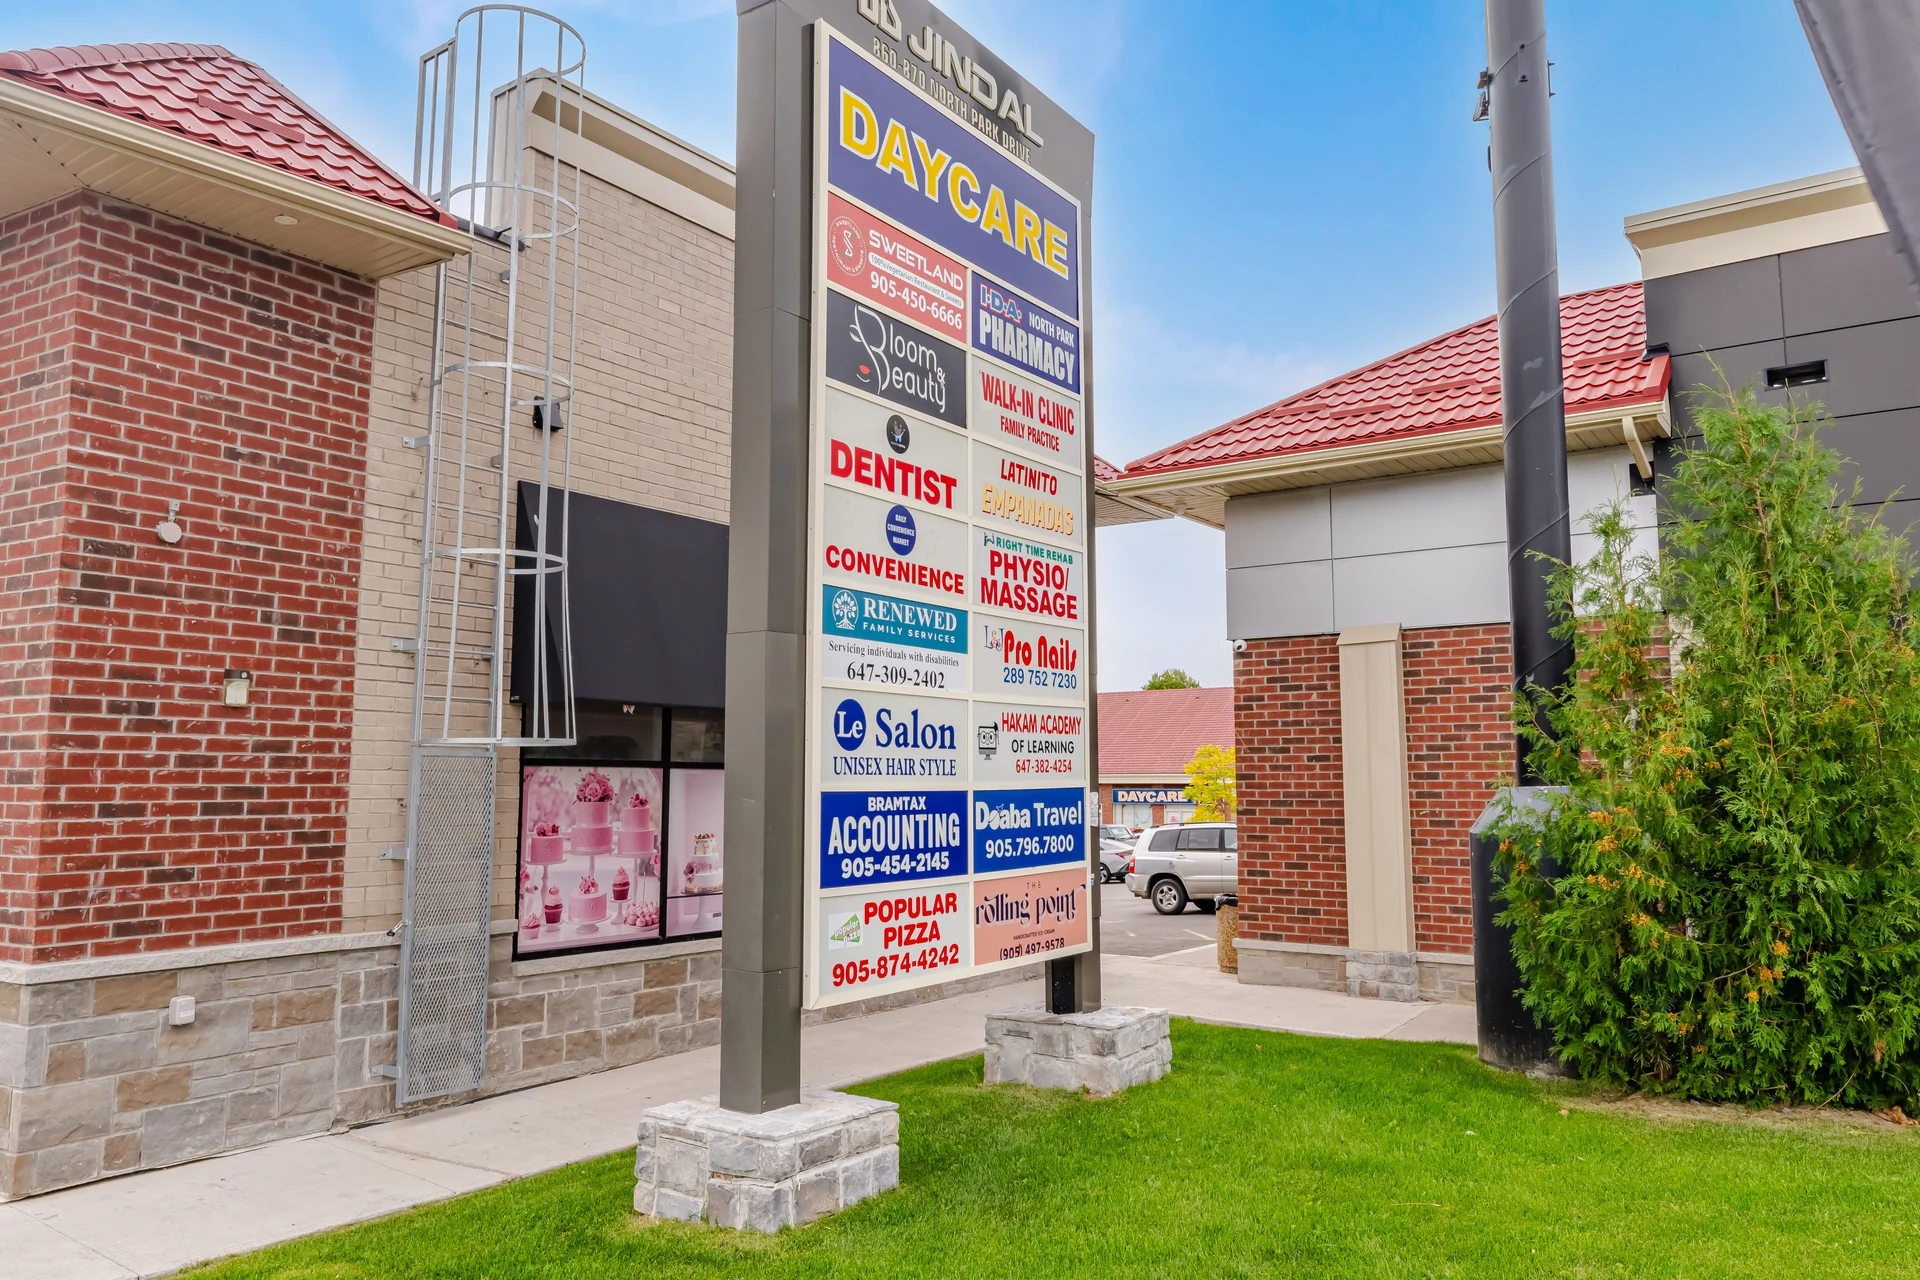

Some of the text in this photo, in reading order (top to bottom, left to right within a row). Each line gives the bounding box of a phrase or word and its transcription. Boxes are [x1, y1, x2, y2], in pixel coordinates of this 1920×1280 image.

[873, 36, 1031, 165] 860-870 NORTH PARK DRIVE
[907, 26, 1043, 147] JINDAL
[840, 85, 1068, 280] DAYCARE
[869, 229, 964, 291] SWEETLAND
[870, 271, 963, 330] 905-450-6666
[914, 276, 941, 296] Restaurant
[945, 293, 962, 307] Sweets
[980, 309, 1075, 385] PHARMACY
[1029, 312, 1075, 348] NORTH PARK
[936, 367, 946, 384] &
[981, 371, 1075, 436] WALK-IN CLINIC
[1000, 415, 1059, 452] FAMILY PRACTICE
[830, 438, 957, 509] DENTIST
[1000, 458, 1057, 495] LATINITO
[981, 482, 1074, 536] EMPANADAS
[996, 537, 1073, 565] RIGHT TIME REHAB
[825, 544, 964, 595] CONVENIENCE
[990, 549, 1069, 592] PHYSIO/
[863, 597, 957, 632] RENEWED
[981, 577, 1077, 620] MASSAGE
[863, 622, 956, 644] FAMILY SERVICES
[1004, 630, 1032, 667] Pro
[828, 640, 960, 667] Servicing individuals with disabilities
[847, 661, 945, 689] 647-309-2402
[1003, 667, 1077, 689] 289 752 7230
[837, 708, 957, 749] Le Salon
[1001, 711, 1081, 735] HAKAM ACADEMY
[1011, 739, 1075, 754] OF LEARNING
[833, 756, 957, 776] UNISEX HAIR STYLE
[1015, 759, 1072, 774] 647-382-4254
[867, 796, 926, 812] BRAMTAX
[1117, 790, 1188, 802] DAYCARE
[975, 800, 1082, 830] Doaba Travel
[828, 812, 960, 855] ACCOUNTING
[985, 834, 1074, 859] 905.796.7800
[841, 851, 950, 879] 905-454-2145
[1026, 881, 1041, 889] THE
[864, 892, 957, 925] POPULAR
[975, 884, 1086, 925] rolling point
[883, 920, 940, 950] PIZZA
[1000, 937, 1065, 960] (905) 497-9578
[1013, 931, 1037, 941] HANDCRAFTED
[832, 943, 959, 987] 905-874-4242
